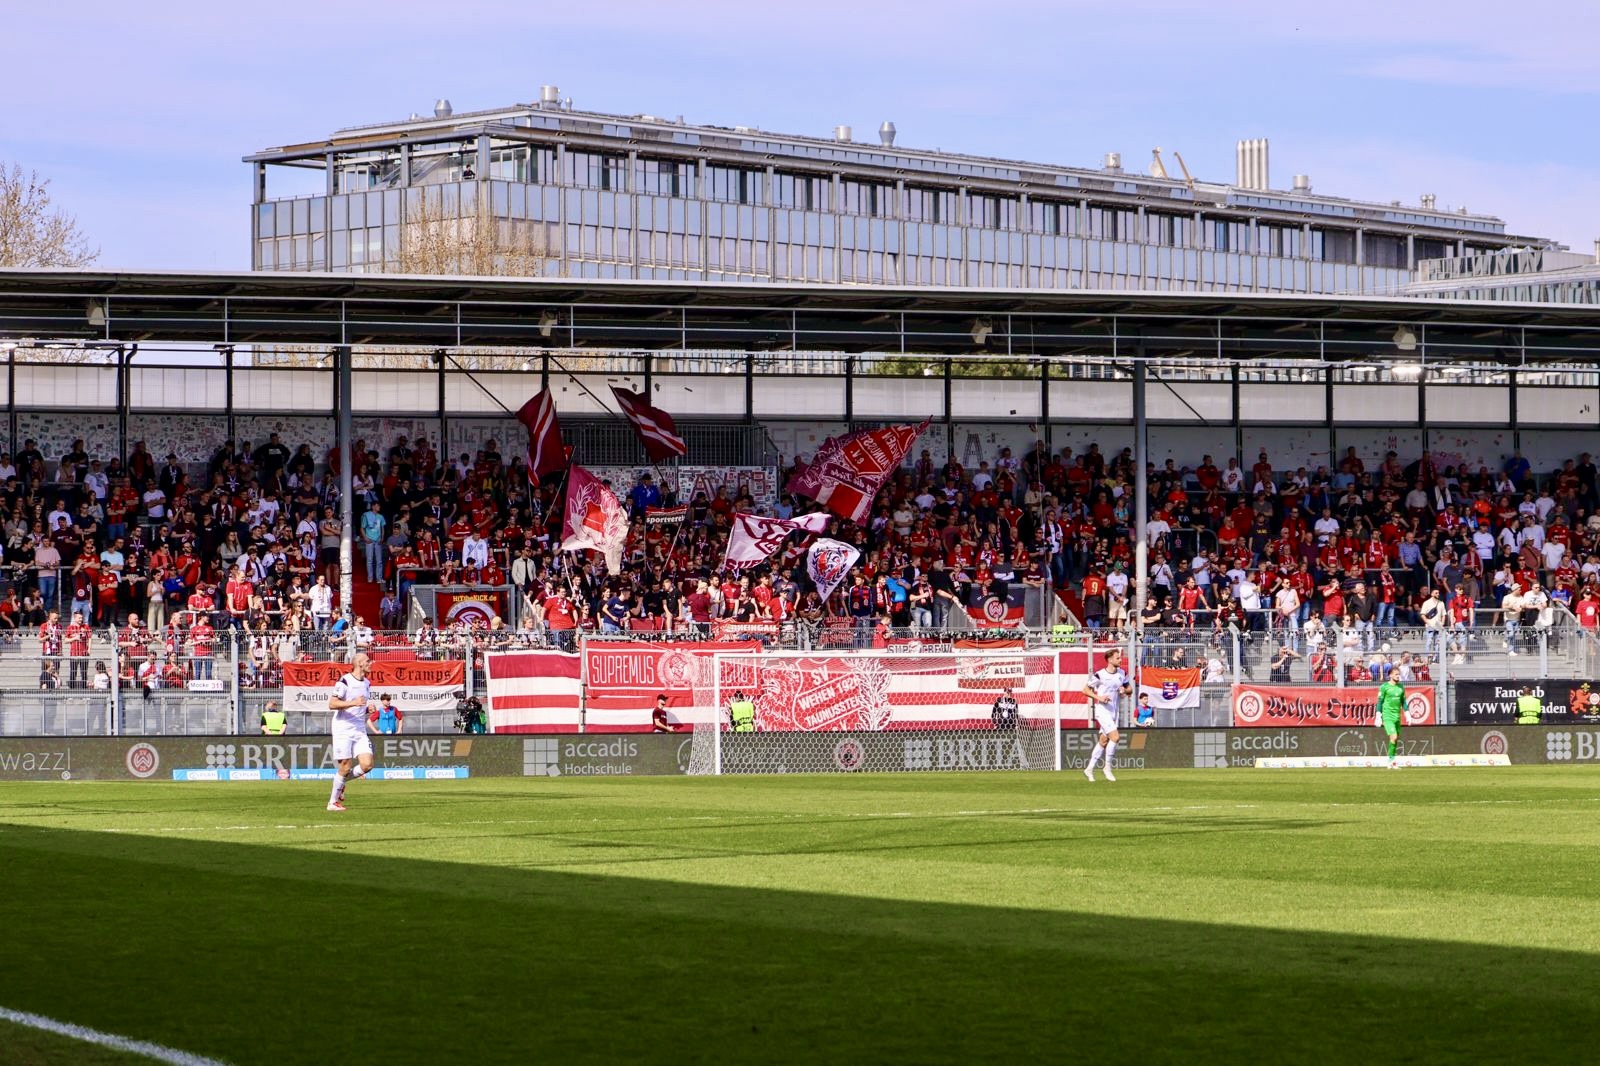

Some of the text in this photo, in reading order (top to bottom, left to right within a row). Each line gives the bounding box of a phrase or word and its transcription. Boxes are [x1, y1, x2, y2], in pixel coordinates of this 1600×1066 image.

[295, 667, 320, 682] Die
[591, 655, 655, 684] SUPREMUS
[811, 665, 829, 686] SV
[994, 666, 1023, 675] ALLER
[295, 691, 329, 702] Fanclub
[798, 688, 836, 711] WEHEN
[1469, 702, 1497, 715] SVW
[383, 739, 451, 757] ESWE
[565, 737, 638, 757] accadis
[1232, 731, 1299, 750] accadis
[938, 738, 1029, 769] BRITA
[565, 762, 632, 775] Hochschule
